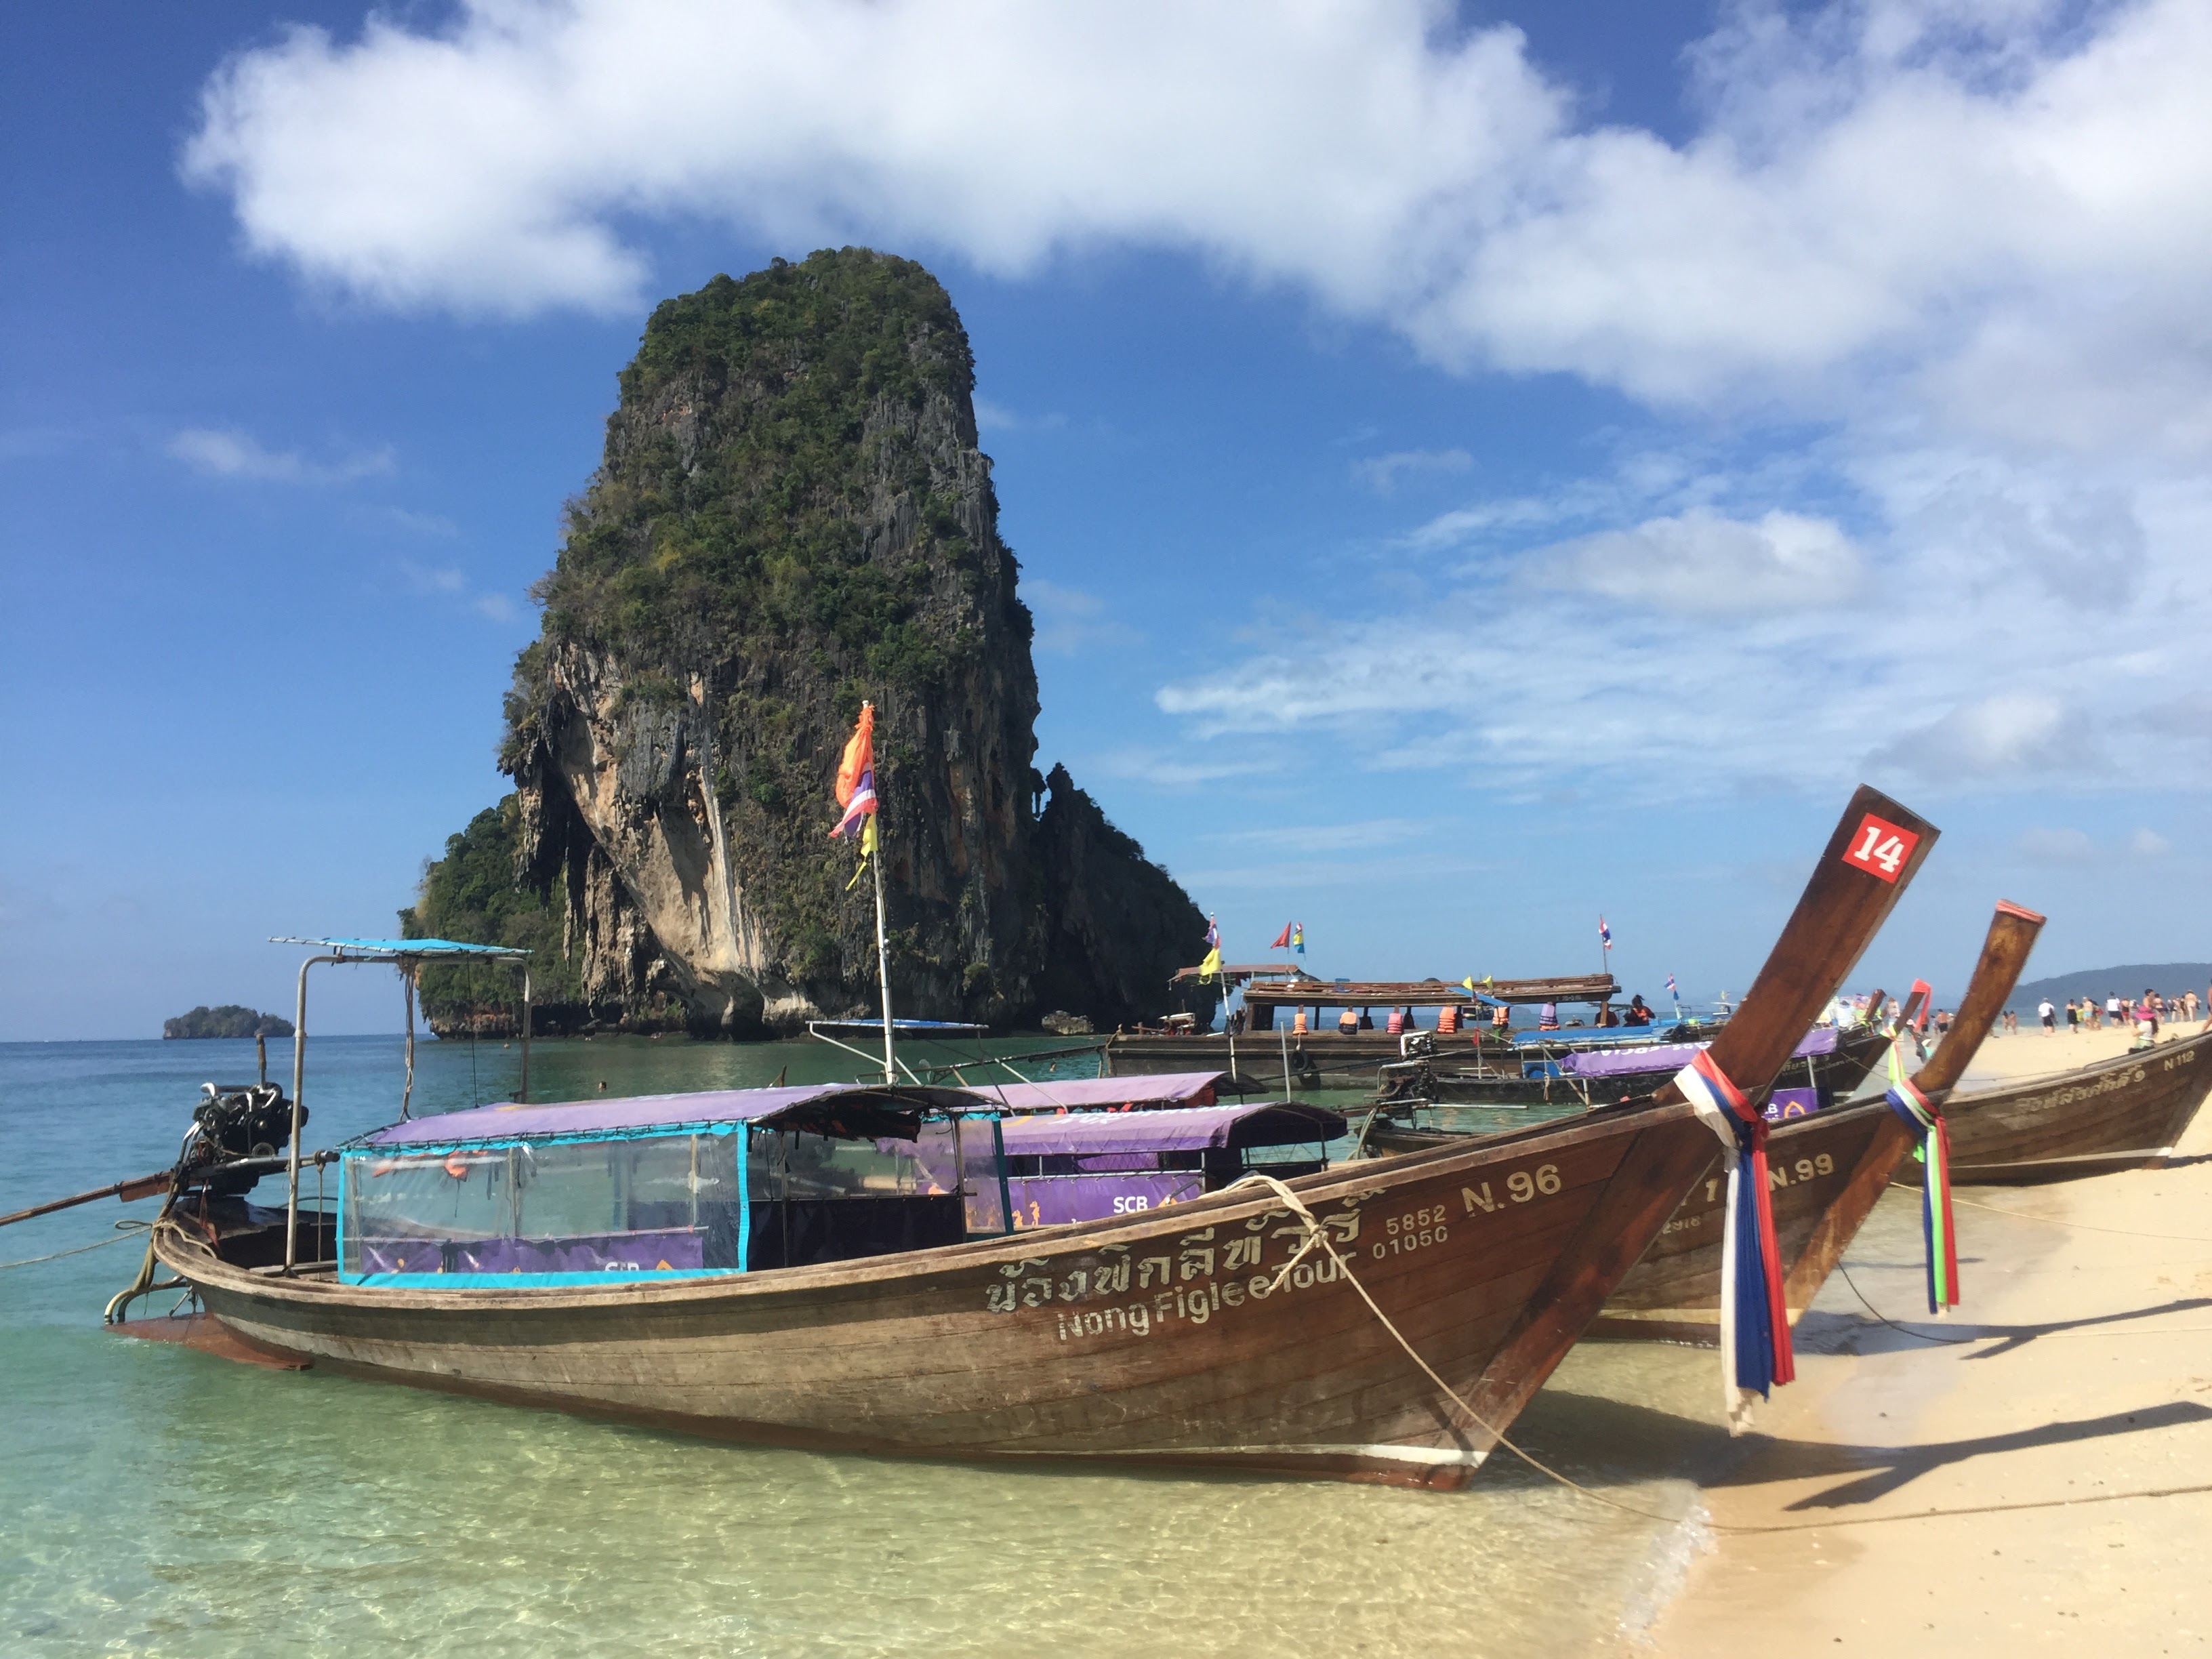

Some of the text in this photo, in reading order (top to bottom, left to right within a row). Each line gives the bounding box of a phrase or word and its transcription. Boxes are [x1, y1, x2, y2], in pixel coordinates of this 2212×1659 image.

[1853, 826, 1904, 873] 14
[2164, 1050, 2195, 1071] N 112
[1767, 1153, 1835, 1192] N.99
[1113, 1196, 1148, 1213] SCB
[1460, 1164, 1561, 1218] N.96
[1386, 1205, 1447, 1235] 5852
[1372, 1225, 1448, 1259] 01050
[1057, 1302, 1151, 1341] Nong
